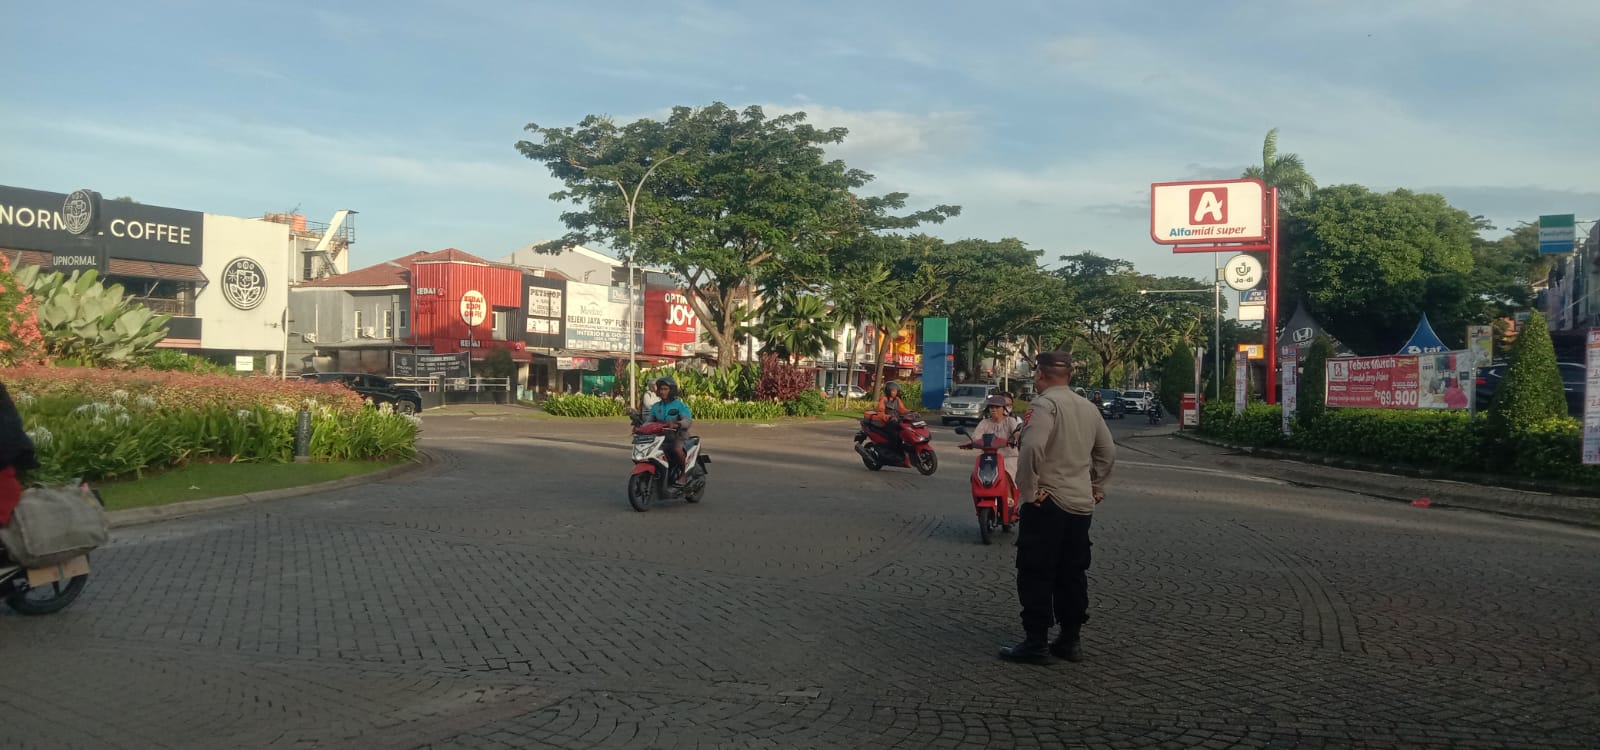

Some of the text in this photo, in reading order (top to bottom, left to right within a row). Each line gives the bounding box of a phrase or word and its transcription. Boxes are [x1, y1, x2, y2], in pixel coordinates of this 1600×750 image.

[110, 219, 191, 245] COFFEE
[1169, 226, 1246, 237] Alfamidi super
[52, 255, 97, 266] UPNORMAL
[587, 316, 601, 325] JAYA
[665, 304, 695, 326] JOY
[1349, 360, 1370, 370] Tebus
[1371, 357, 1395, 369] Murah
